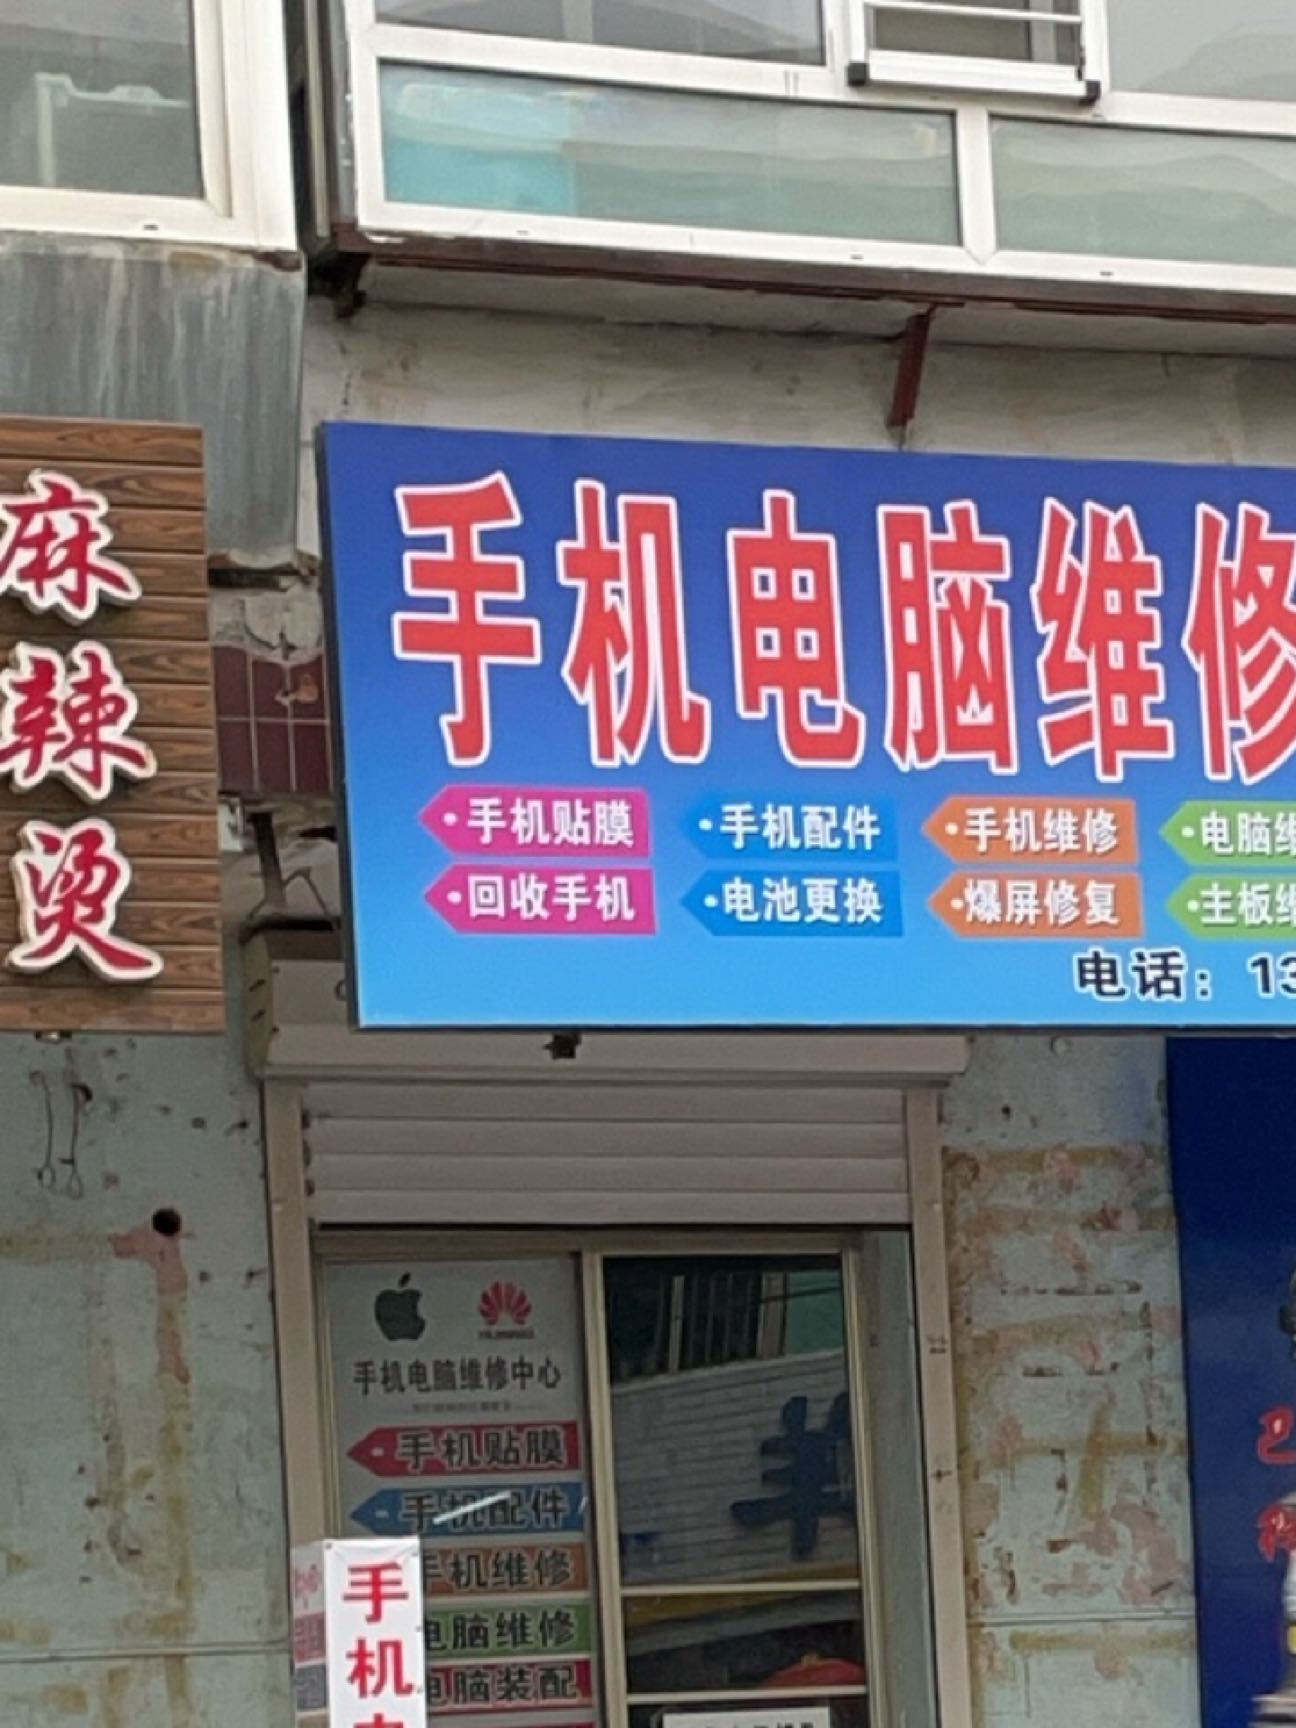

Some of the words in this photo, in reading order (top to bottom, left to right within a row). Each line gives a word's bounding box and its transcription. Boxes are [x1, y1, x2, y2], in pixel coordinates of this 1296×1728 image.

[0, 468, 164, 979] 麻辣烫
[466, 797, 634, 848] 手机贴膜
[720, 803, 881, 852] 手机配件
[964, 808, 1119, 855] 手机维修
[467, 874, 635, 921] 回收手机
[724, 877, 883, 924] 电池更换
[963, 879, 1120, 926] 爆屏修复
[353, 1354, 562, 1396] 手机电脑维修中心
[398, 1425, 566, 1473] 手机贴膜
[402, 1487, 568, 1533] 手机配件
